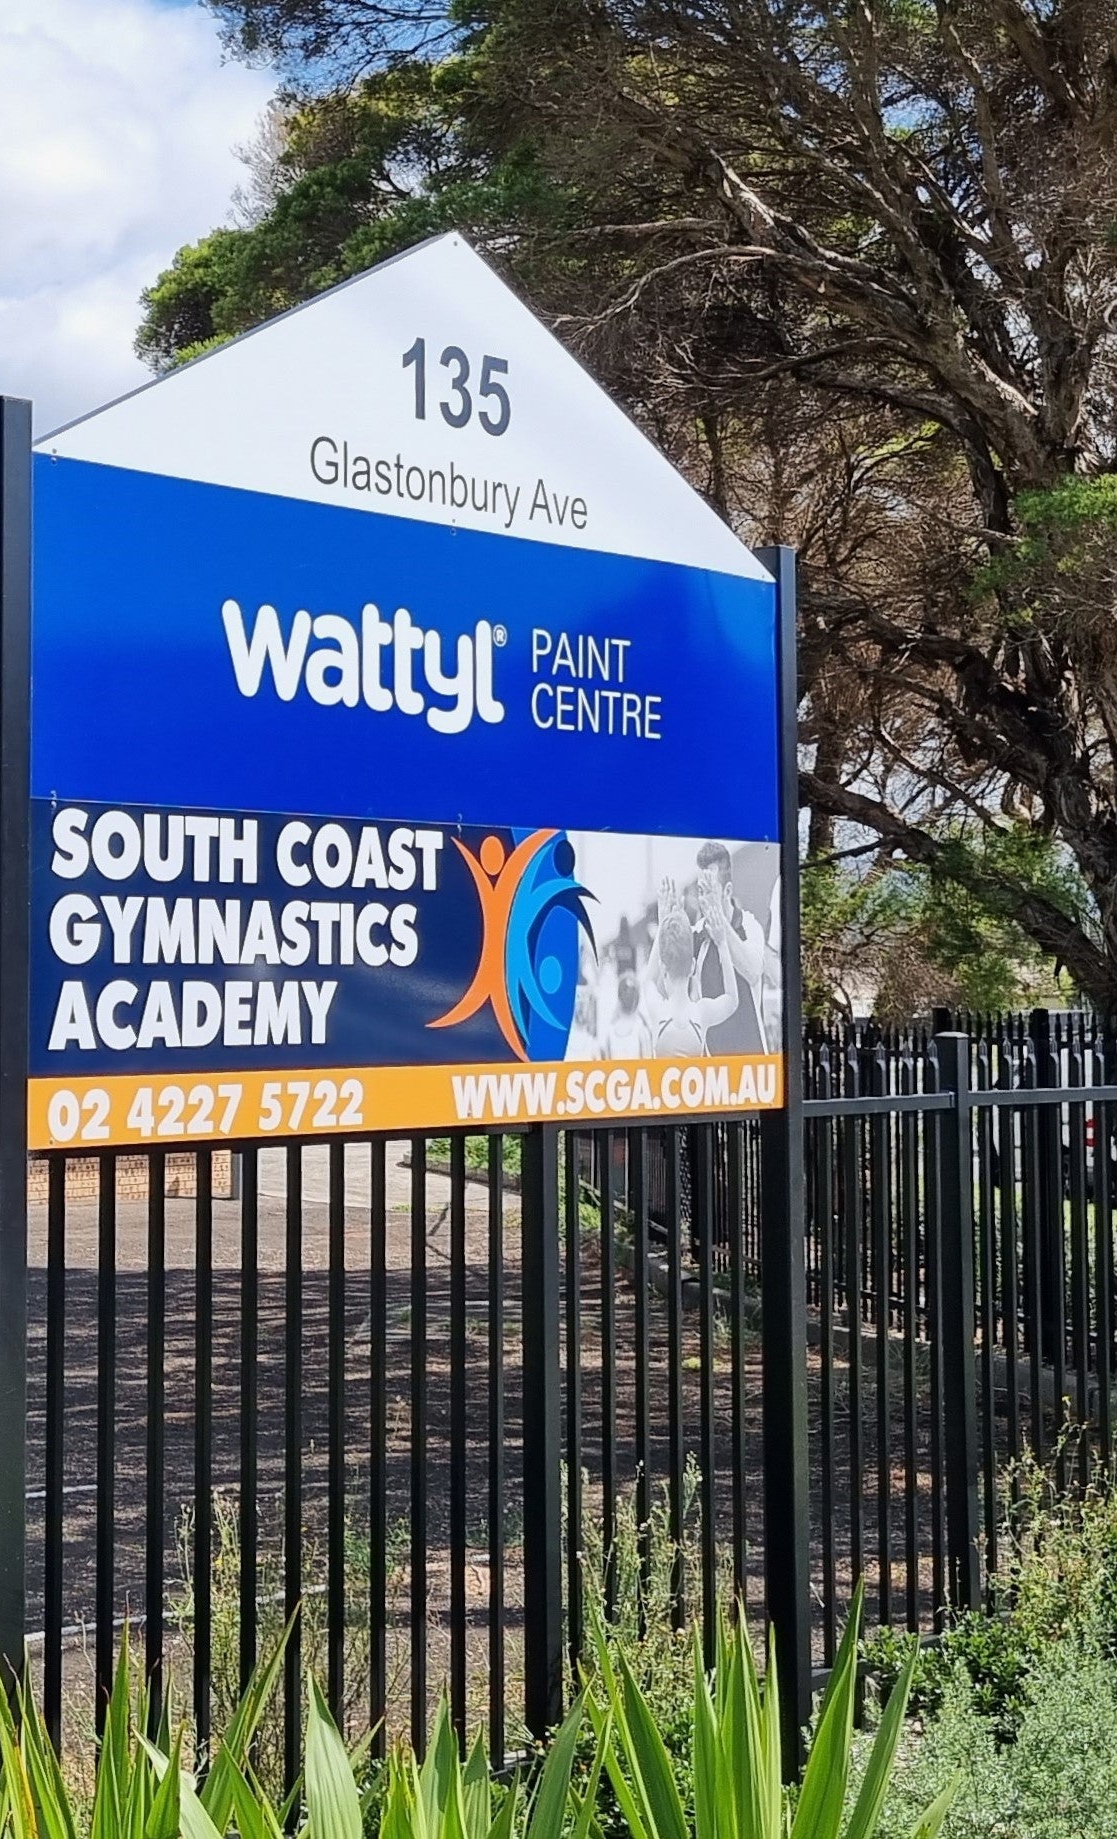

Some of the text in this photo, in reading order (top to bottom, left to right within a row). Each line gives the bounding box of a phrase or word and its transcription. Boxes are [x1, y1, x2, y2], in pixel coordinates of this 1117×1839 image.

[402, 337, 511, 436] 135
[310, 436, 588, 529] Glastonbury Ave
[532, 629, 631, 683] PAINT
[532, 682, 662, 739] CENTRE
[51, 809, 444, 891] SOUTH COAST
[48, 894, 418, 967] GYMNASTICS
[47, 981, 338, 1051] ACADEMY
[47, 1080, 363, 1142] 02 4227 5722
[452, 1064, 776, 1119] WWW.SCGA.COM.AU
